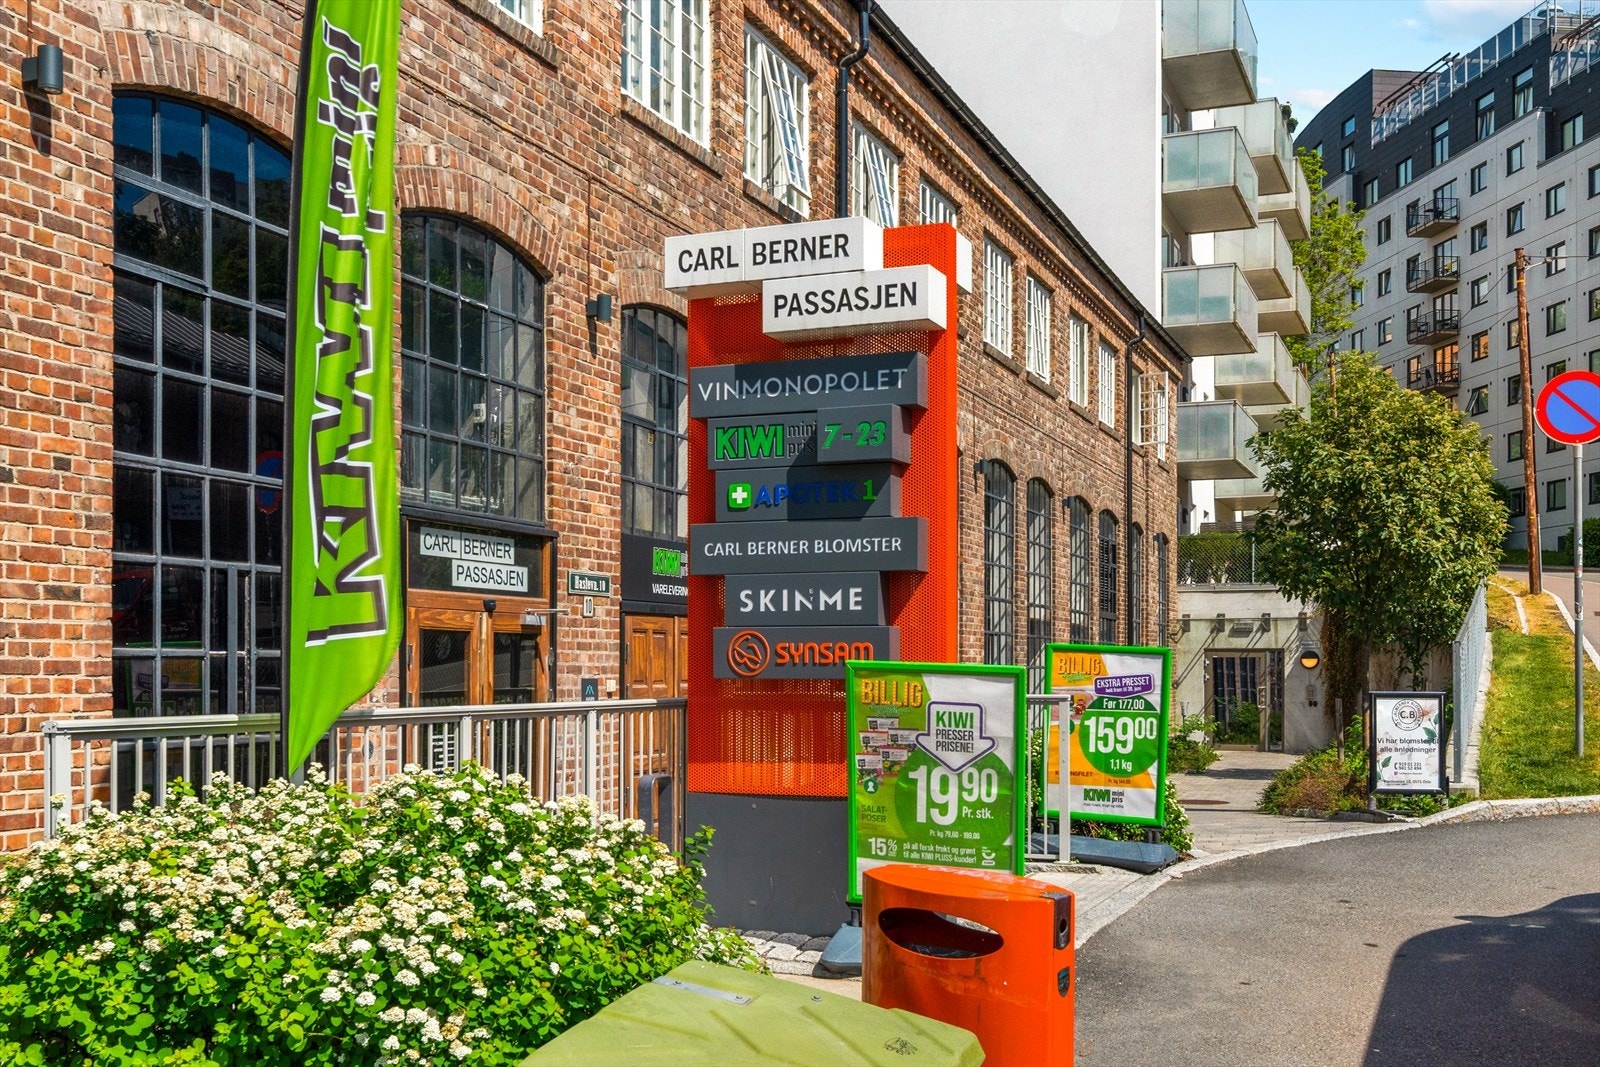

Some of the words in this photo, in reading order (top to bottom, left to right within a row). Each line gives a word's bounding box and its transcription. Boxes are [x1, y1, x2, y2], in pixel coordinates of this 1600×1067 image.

[317, 15, 361, 217] mini
[354, 64, 387, 233] is
[678, 245, 739, 273] CARL
[752, 233, 850, 266] BERNER
[773, 281, 918, 318] PASSASJEN
[698, 369, 908, 402] VINMONOPOLET
[305, 221, 388, 648] KIWI
[714, 423, 785, 461] KIWI
[787, 420, 817, 438] mini
[787, 439, 816, 459] pris
[754, 480, 859, 506] APOTEK
[862, 479, 877, 501] 1
[424, 532, 457, 553] CARL
[463, 537, 512, 560] BERNER
[704, 542, 743, 557] CARL
[747, 540, 809, 555] BERNER
[814, 537, 902, 554] BLOMSTER
[653, 547, 681, 577] KIWI
[456, 565, 524, 587] PASSASJEN
[651, 583, 688, 597] VARELEVERIN
[585, 598, 592, 614] 10
[776, 641, 874, 665] SYNSAM
[1058, 655, 1101, 675] BILLIG
[1096, 679, 1121, 688] EKSTRA
[1121, 676, 1150, 687] PRESSET
[861, 679, 923, 709] BILLIG
[1103, 699, 1117, 710] Før
[1118, 699, 1145, 711] 177,00
[1400, 710, 1416, 719] C.B
[935, 710, 974, 729] KIWI
[935, 729, 974, 742] PRESSER
[935, 740, 974, 754] PRISENE!
[1109, 759, 1121, 770] 1,1
[1121, 759, 1132, 772] kg
[1083, 788, 1111, 803] KIWI
[1111, 789, 1125, 797] mini
[1111, 796, 1124, 804] pris
[861, 804, 888, 815] SALAT-
[861, 814, 887, 823] POSER
[962, 806, 974, 818] Pr.
[975, 806, 994, 819] stk.
[919, 843, 934, 852] fersk
[935, 844, 950, 853] frukt
[951, 847, 959, 855] og
